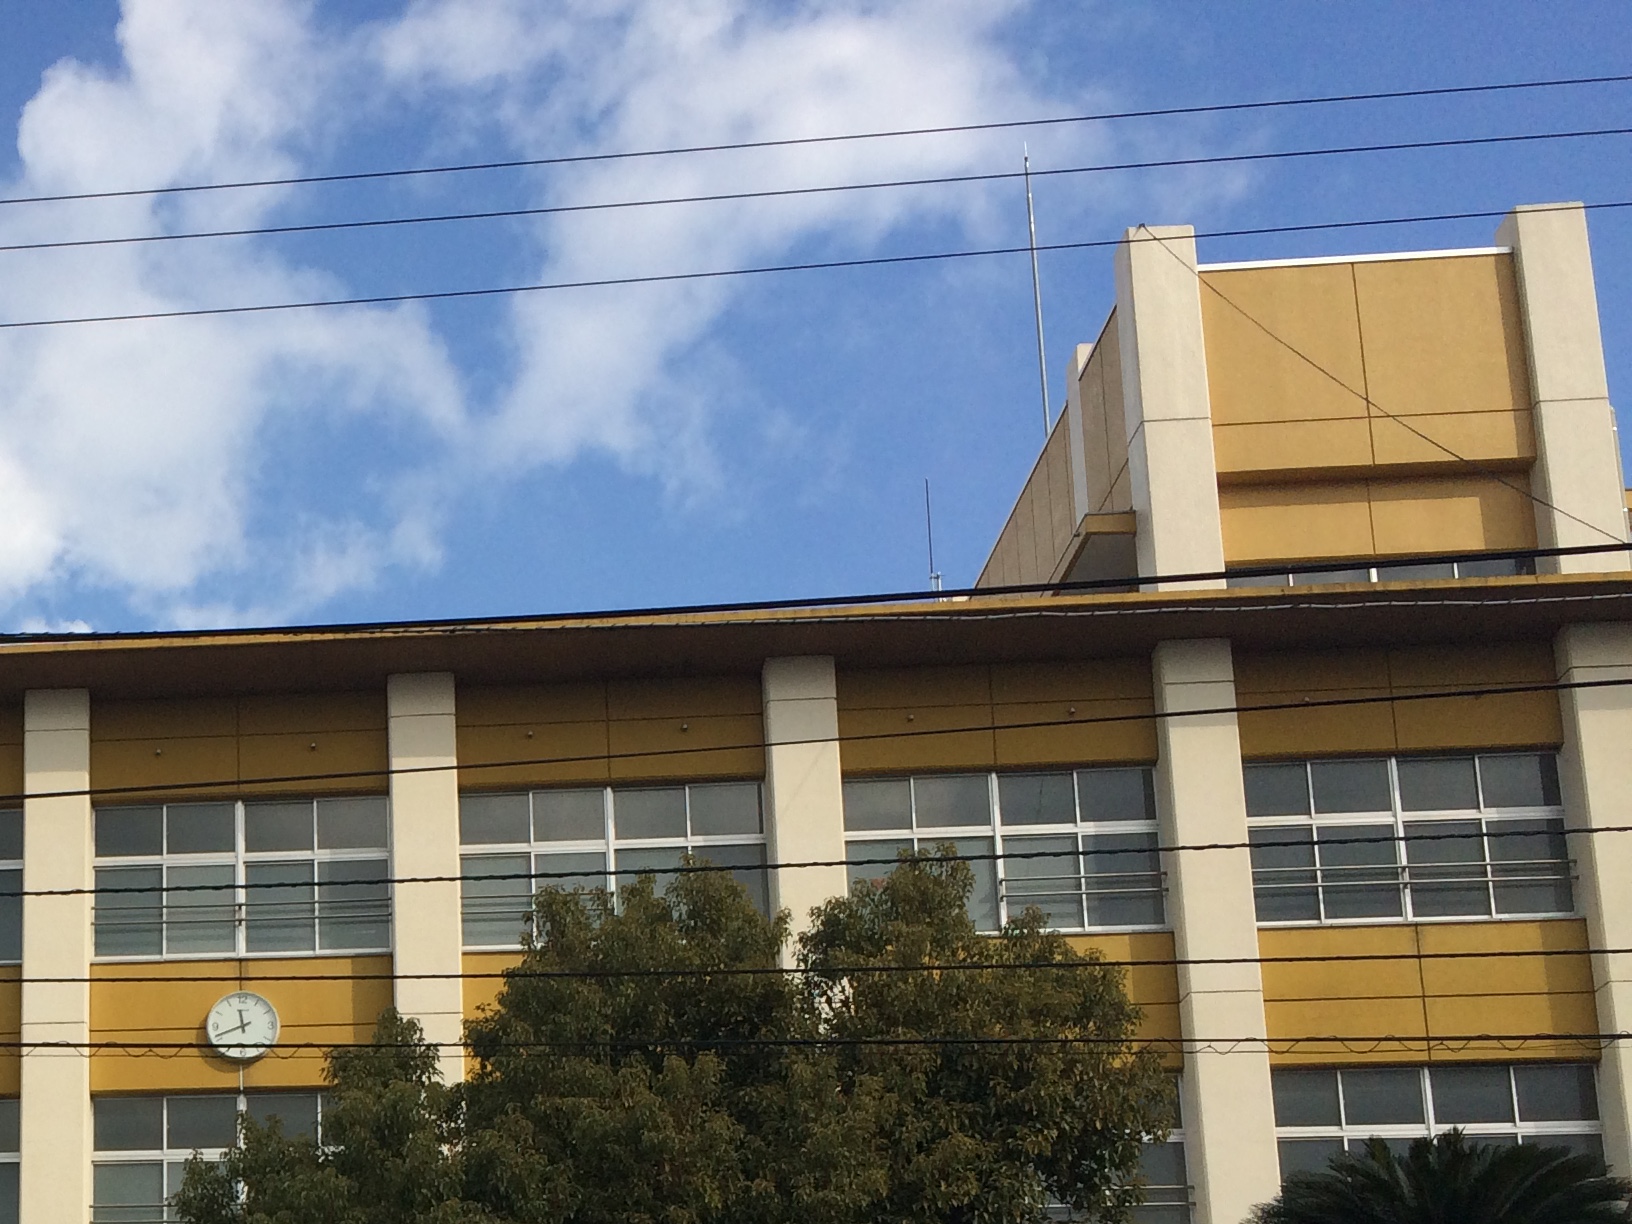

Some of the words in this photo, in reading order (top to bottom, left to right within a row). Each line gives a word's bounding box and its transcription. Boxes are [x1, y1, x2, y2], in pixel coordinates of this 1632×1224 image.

[237, 995, 248, 1004] 12
[212, 1022, 219, 1032] 9
[267, 1020, 275, 1030] 3
[239, 1047, 247, 1058] 6
